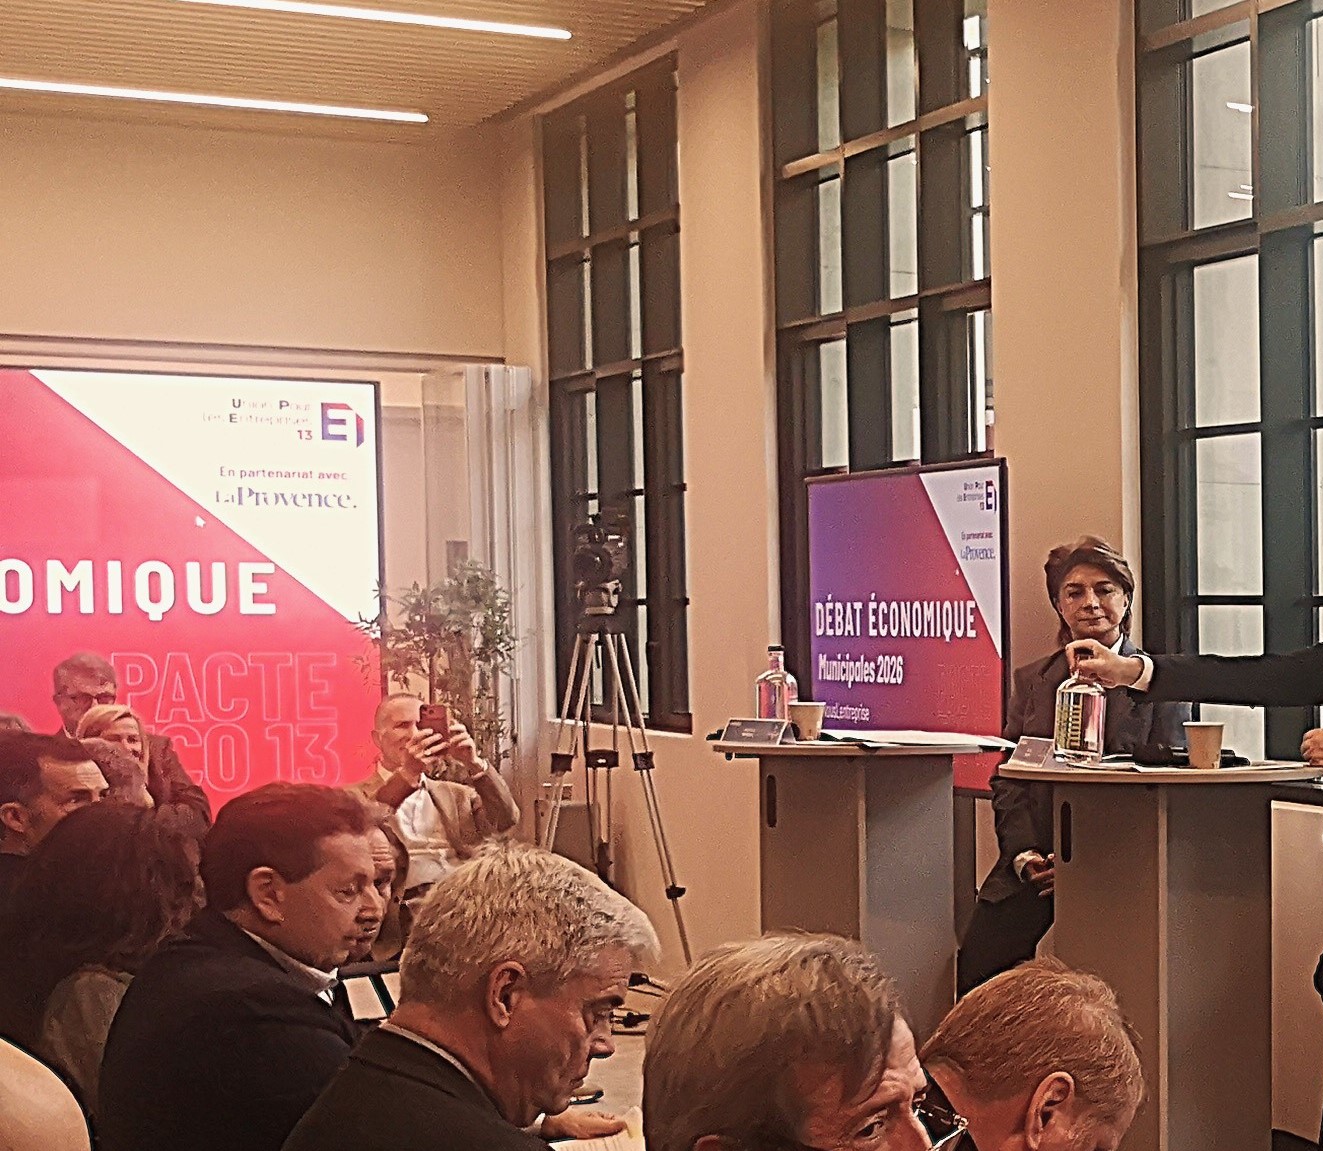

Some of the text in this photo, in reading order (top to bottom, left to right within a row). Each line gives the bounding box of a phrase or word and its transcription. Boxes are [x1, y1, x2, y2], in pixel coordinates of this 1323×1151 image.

[297, 429, 313, 441] 13
[219, 466, 348, 481] En partenariat avec
[0, 558, 277, 622] OMIQUE
[815, 592, 977, 643] DÉBAT ÉCONOMIQUE
[109, 652, 340, 724] PACTE
[818, 653, 904, 689] Municipales 2026
[824, 702, 870, 724] ousLentreprise
[265, 722, 342, 785] 13
